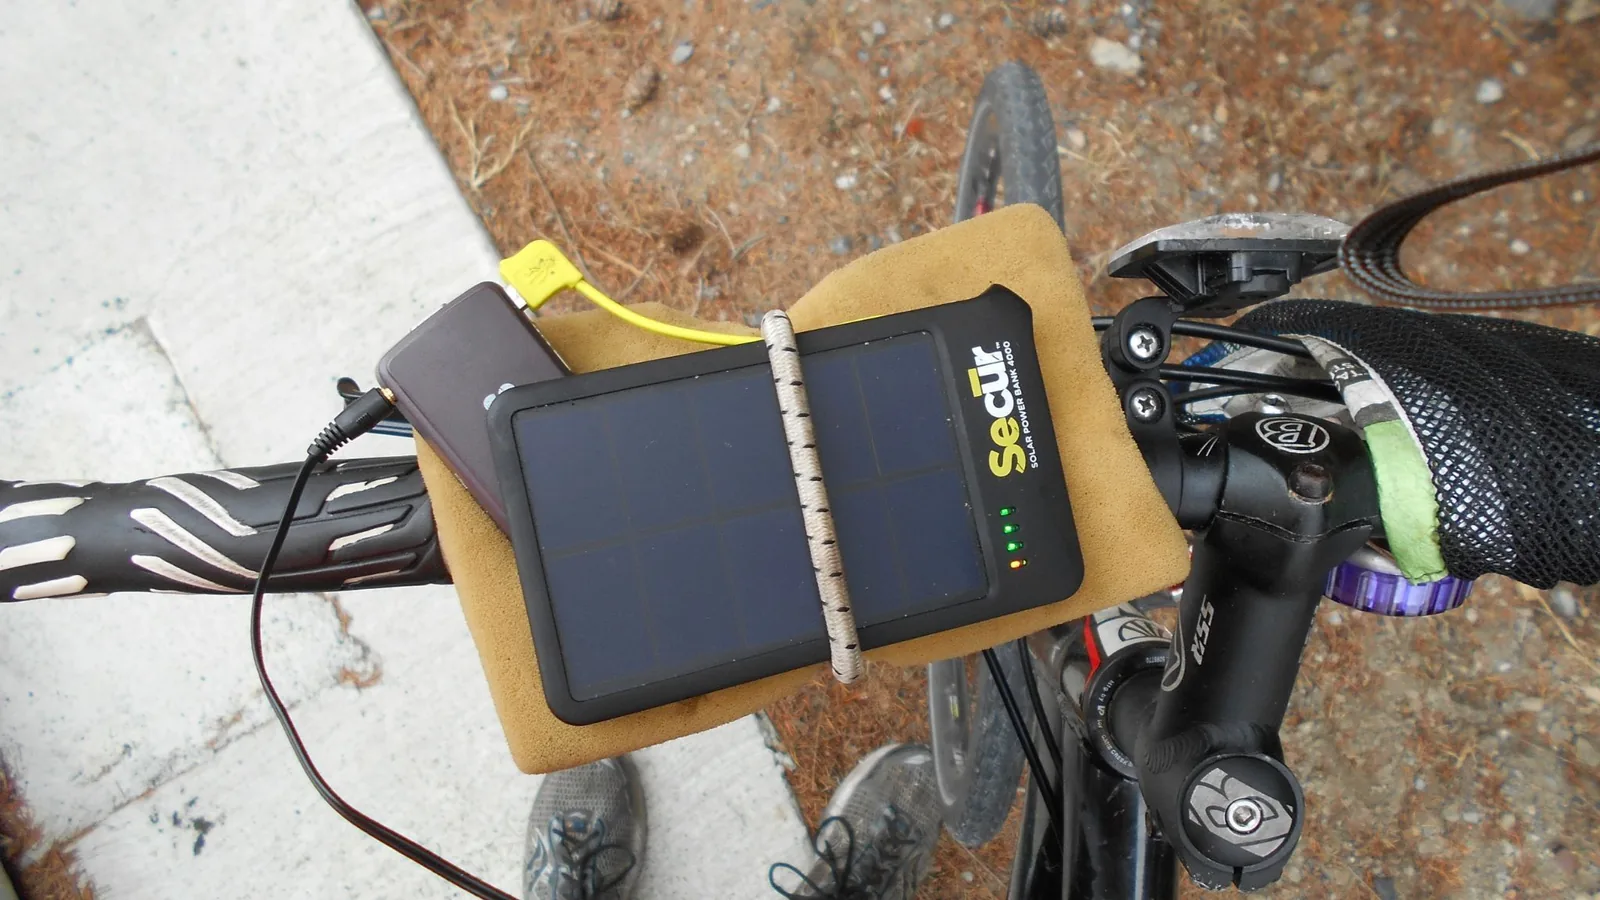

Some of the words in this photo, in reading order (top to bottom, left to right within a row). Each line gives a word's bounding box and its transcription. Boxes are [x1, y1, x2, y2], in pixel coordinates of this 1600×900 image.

[1003, 341, 1015, 366] 4000
[1010, 368, 1022, 396] BANK
[1017, 398, 1030, 434] POWER
[1025, 436, 1038, 469] SOLAR
